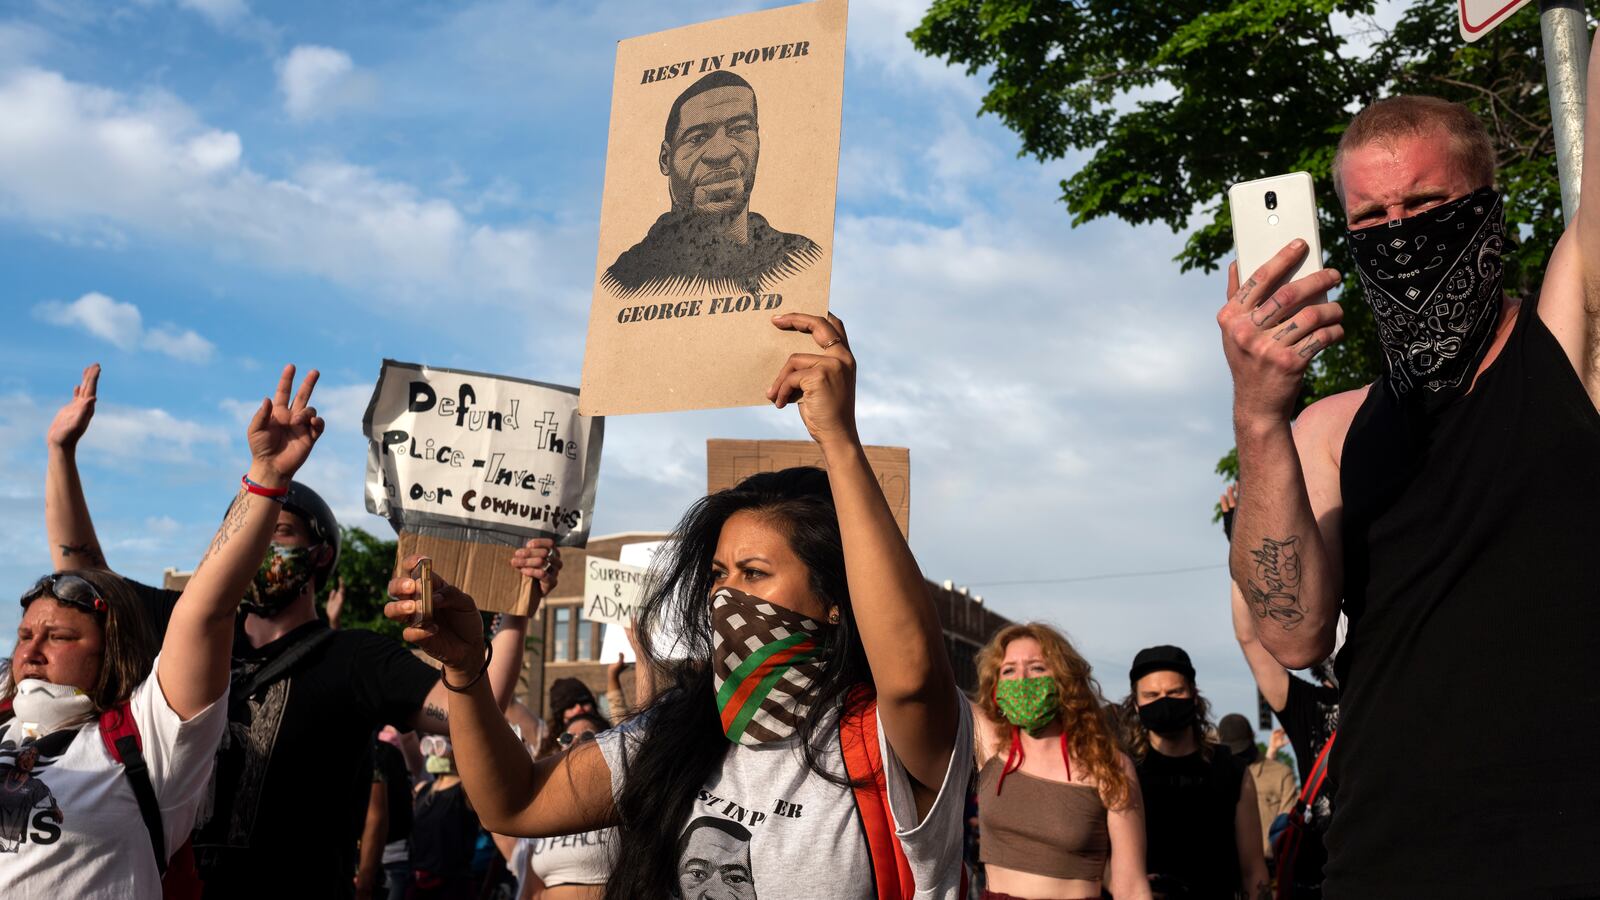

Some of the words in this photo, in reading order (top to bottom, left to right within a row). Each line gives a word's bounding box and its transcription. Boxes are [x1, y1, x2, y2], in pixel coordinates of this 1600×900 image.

[640, 60, 695, 85] REST
[698, 54, 724, 73] IN
[729, 40, 811, 67] POWER
[617, 299, 703, 324] GEORGE
[708, 293, 783, 316] FLOYD
[408, 381, 520, 432] Defund
[534, 411, 577, 460] the
[614, 583, 621, 598] &
[698, 789, 724, 807] ST
[722, 801, 749, 822] IN
